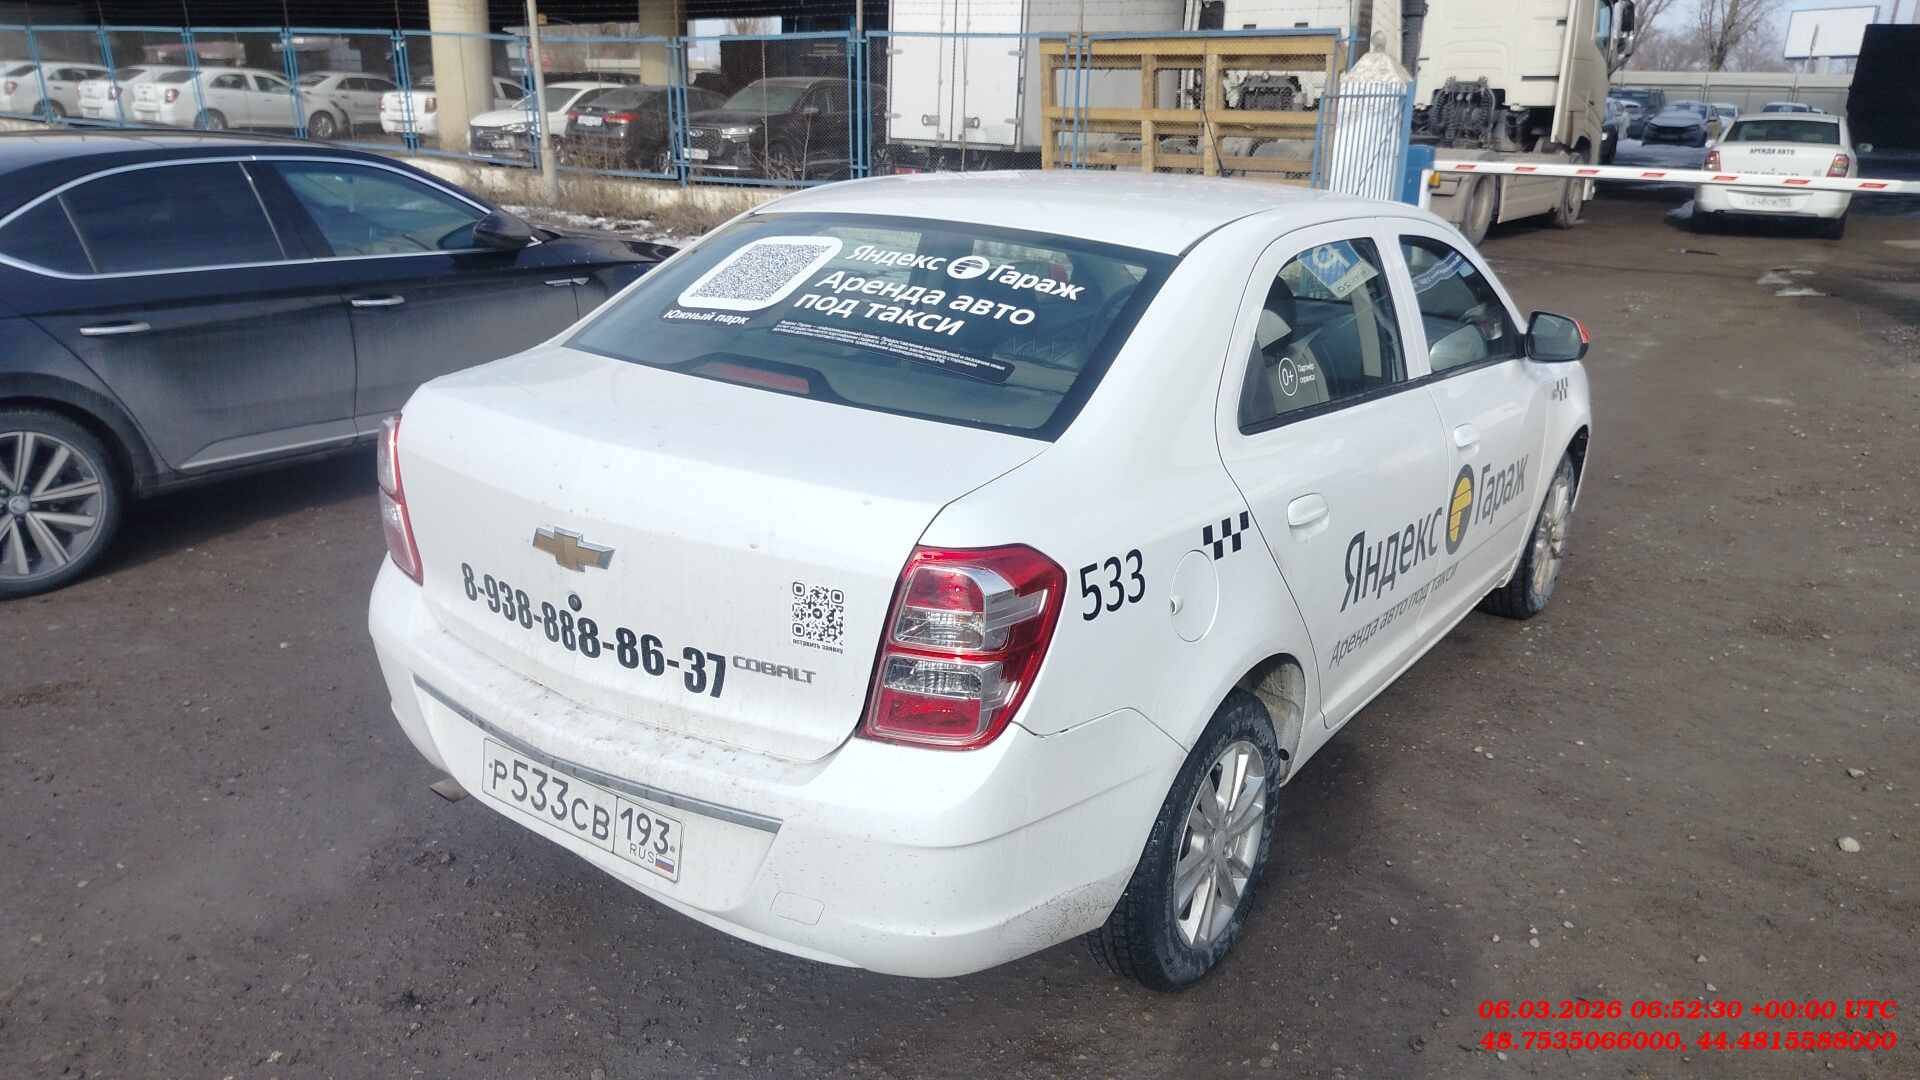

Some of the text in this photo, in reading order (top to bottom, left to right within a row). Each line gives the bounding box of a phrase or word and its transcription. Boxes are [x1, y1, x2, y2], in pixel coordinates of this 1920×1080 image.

[815, 270, 1036, 326] Аренда авто
[845, 245, 1086, 302] Яндекс Гараж
[663, 309, 751, 325] Южный парк
[794, 293, 966, 336] под такси
[1340, 454, 1529, 613] Яндекс Гараж
[1080, 548, 1147, 622] 533
[461, 562, 726, 699] 8-938-888-86-37
[1329, 617, 1380, 670] Аренда
[1379, 598, 1408, 630] авто
[1407, 582, 1431, 610] под
[733, 654, 817, 684] COBALT
[492, 759, 671, 855] Р533СВ 193
[629, 842, 656, 865] RUS
